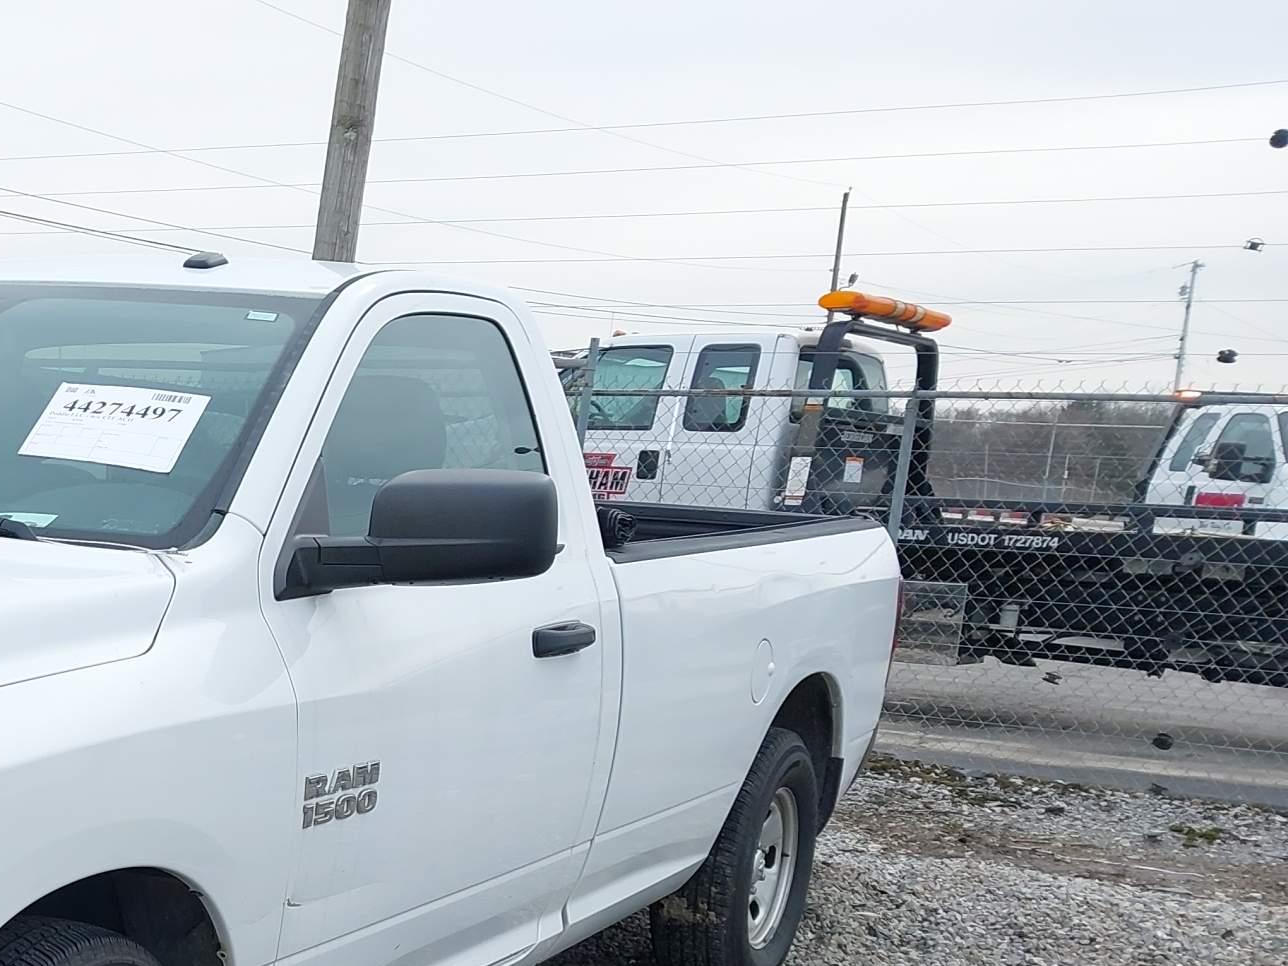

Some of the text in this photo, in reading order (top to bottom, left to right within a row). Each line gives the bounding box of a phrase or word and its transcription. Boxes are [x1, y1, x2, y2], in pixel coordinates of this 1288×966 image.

[63, 399, 184, 422] 44274497
[947, 532, 999, 546] USDOT
[1003, 534, 1060, 549] 1727874
[303, 761, 381, 802] RAM
[302, 788, 378, 830] 1500
